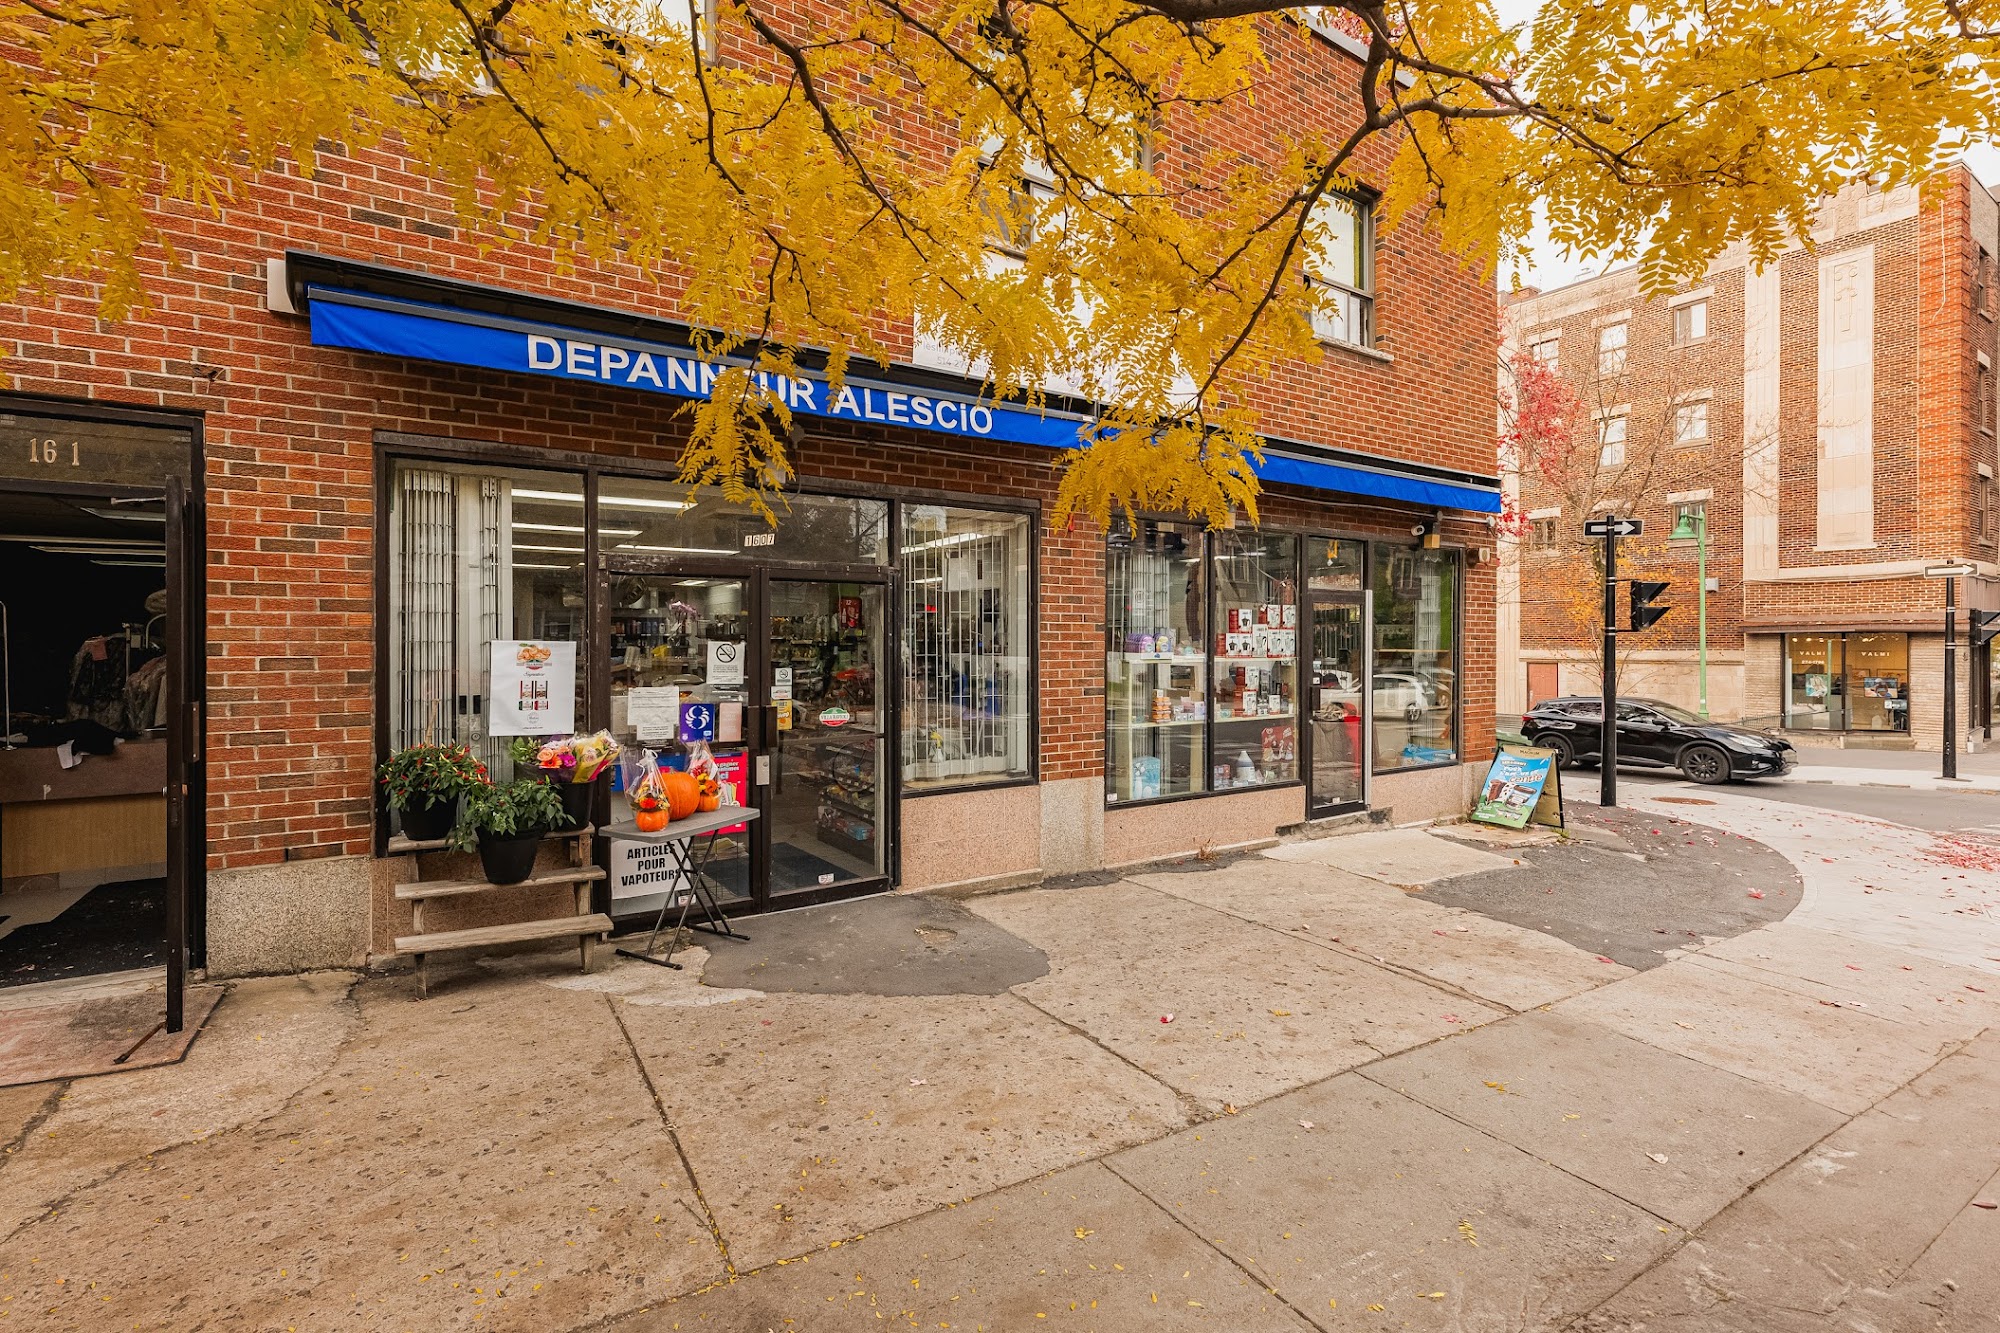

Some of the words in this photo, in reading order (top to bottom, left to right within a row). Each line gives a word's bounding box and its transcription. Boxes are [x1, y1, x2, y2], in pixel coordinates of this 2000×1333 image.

[527, 334, 818, 411] DEPANNUR
[746, 534, 775, 546] 1607
[637, 858, 666, 872] POUR
